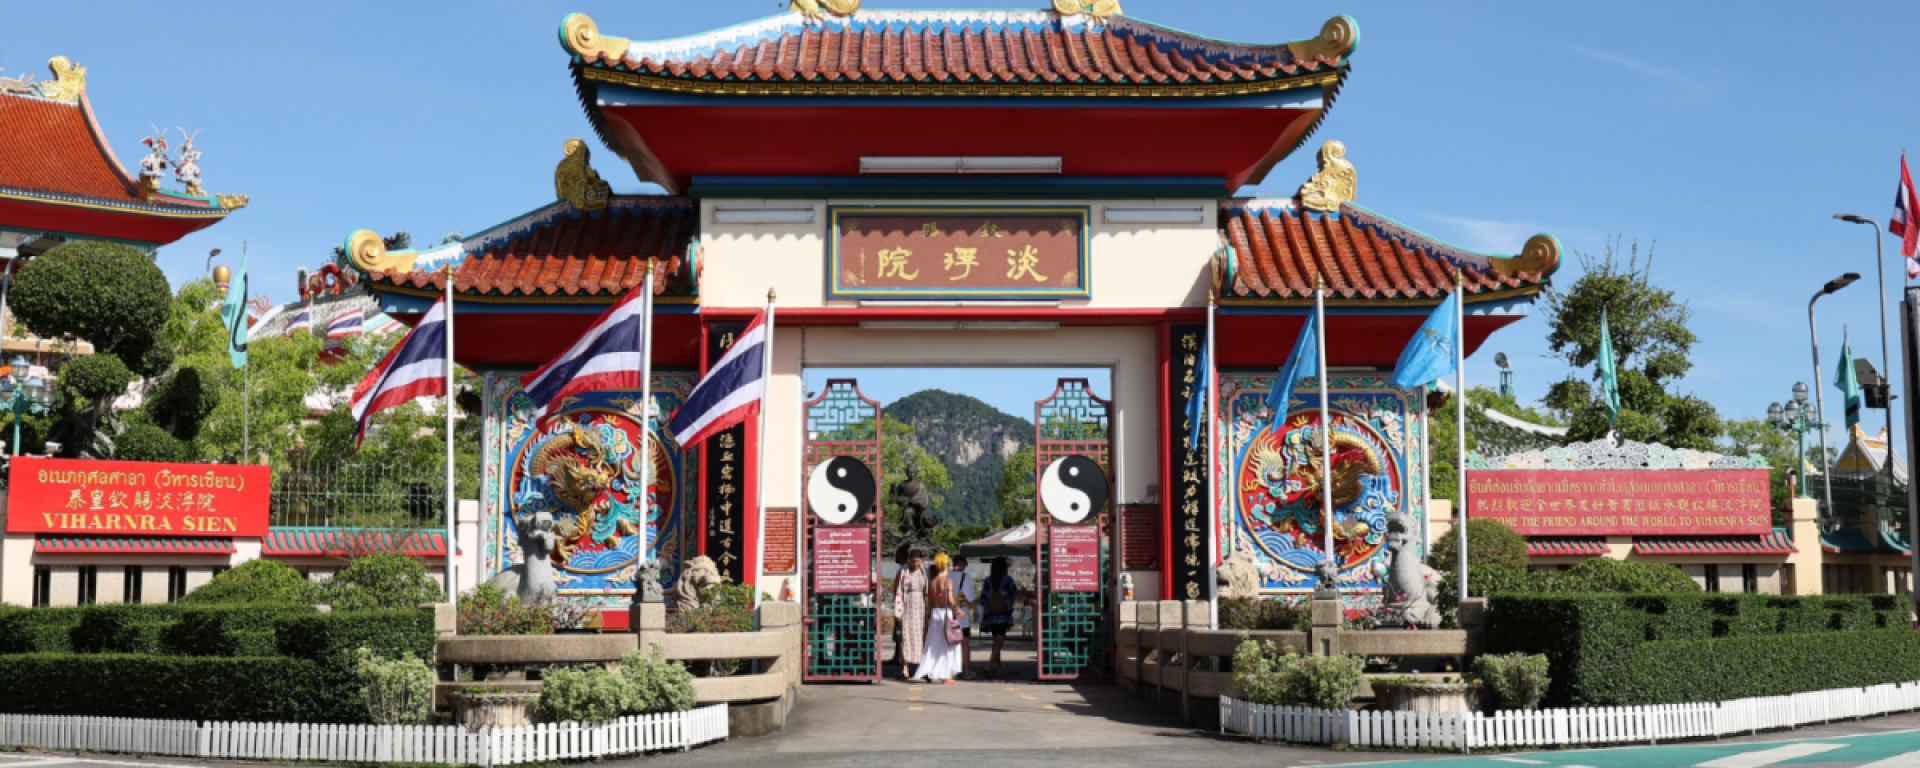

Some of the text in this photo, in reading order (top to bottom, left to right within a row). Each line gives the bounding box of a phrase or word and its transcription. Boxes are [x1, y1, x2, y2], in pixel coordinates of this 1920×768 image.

[41, 511, 238, 532] VIHARNRA SIEN
[1521, 516, 1540, 527] THE
[1543, 516, 1577, 527] FRIEND
[1580, 516, 1618, 526] AROUND
[1621, 516, 1639, 526] THE
[1642, 516, 1677, 526] WORLD
[1680, 516, 1692, 526] TO
[1695, 516, 1744, 526] VIHARNRA
[1747, 516, 1769, 526] SIEN
